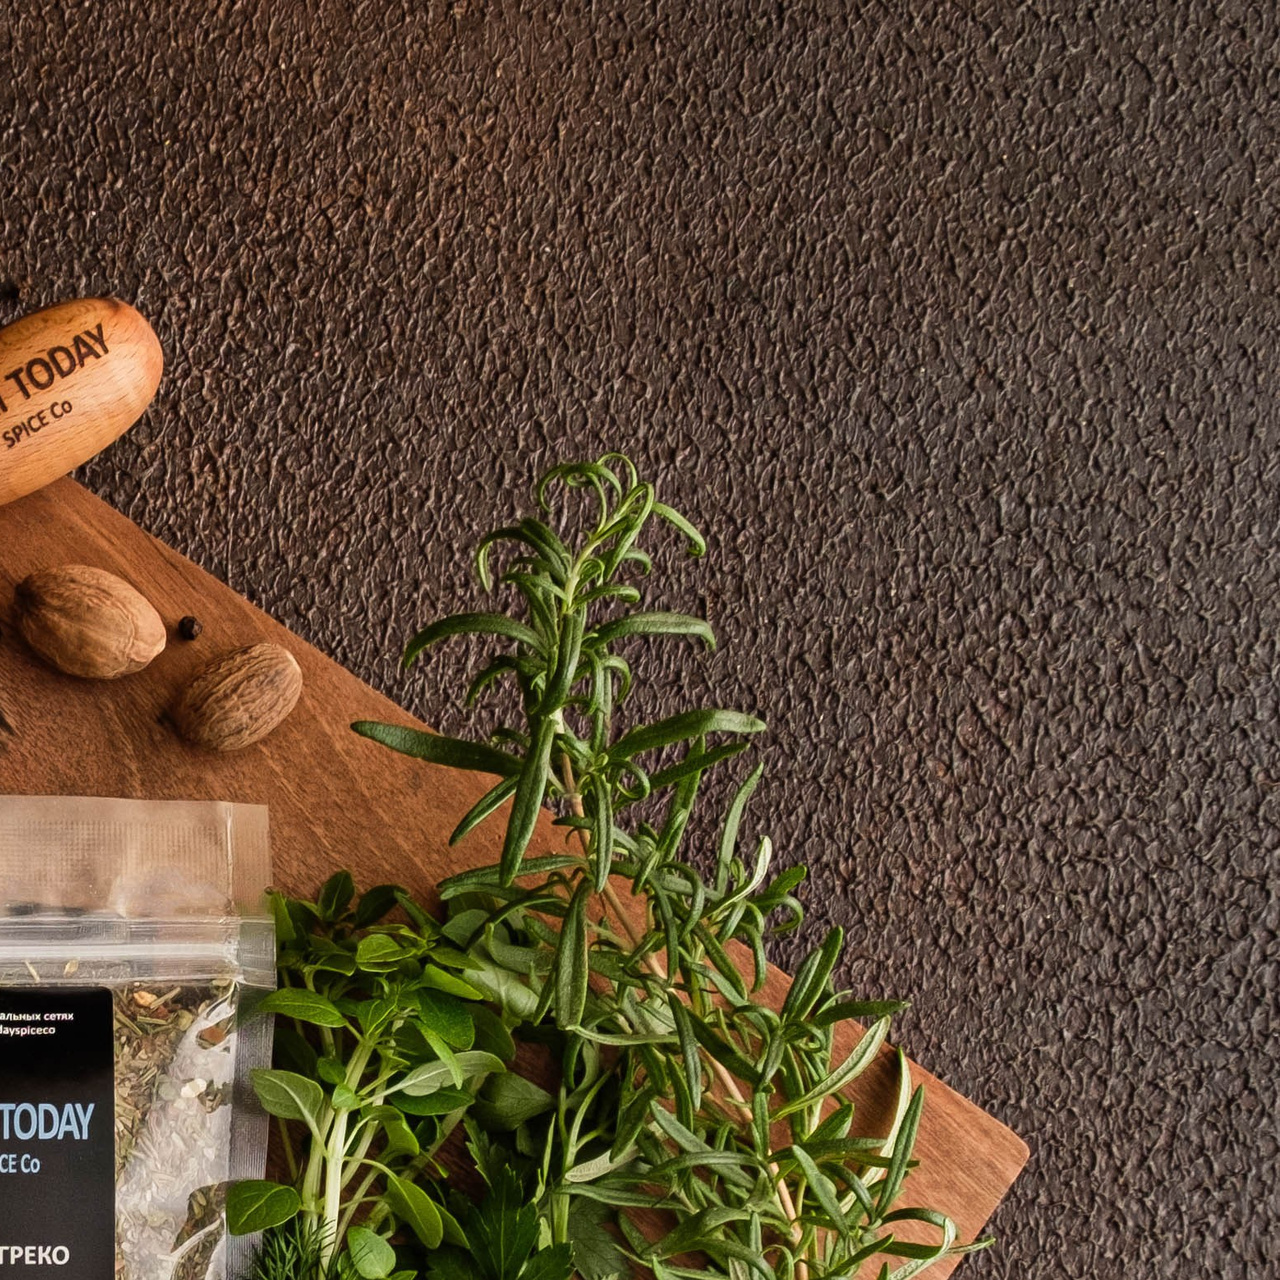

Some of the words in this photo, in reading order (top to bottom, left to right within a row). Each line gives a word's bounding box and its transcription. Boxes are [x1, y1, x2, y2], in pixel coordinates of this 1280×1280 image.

[5, 323, 109, 400] TODAY
[2, 410, 49, 448] SPICE
[50, 400, 73, 420] Co
[43, 1012, 74, 1021] сетях
[20, 1153, 41, 1174] Co
